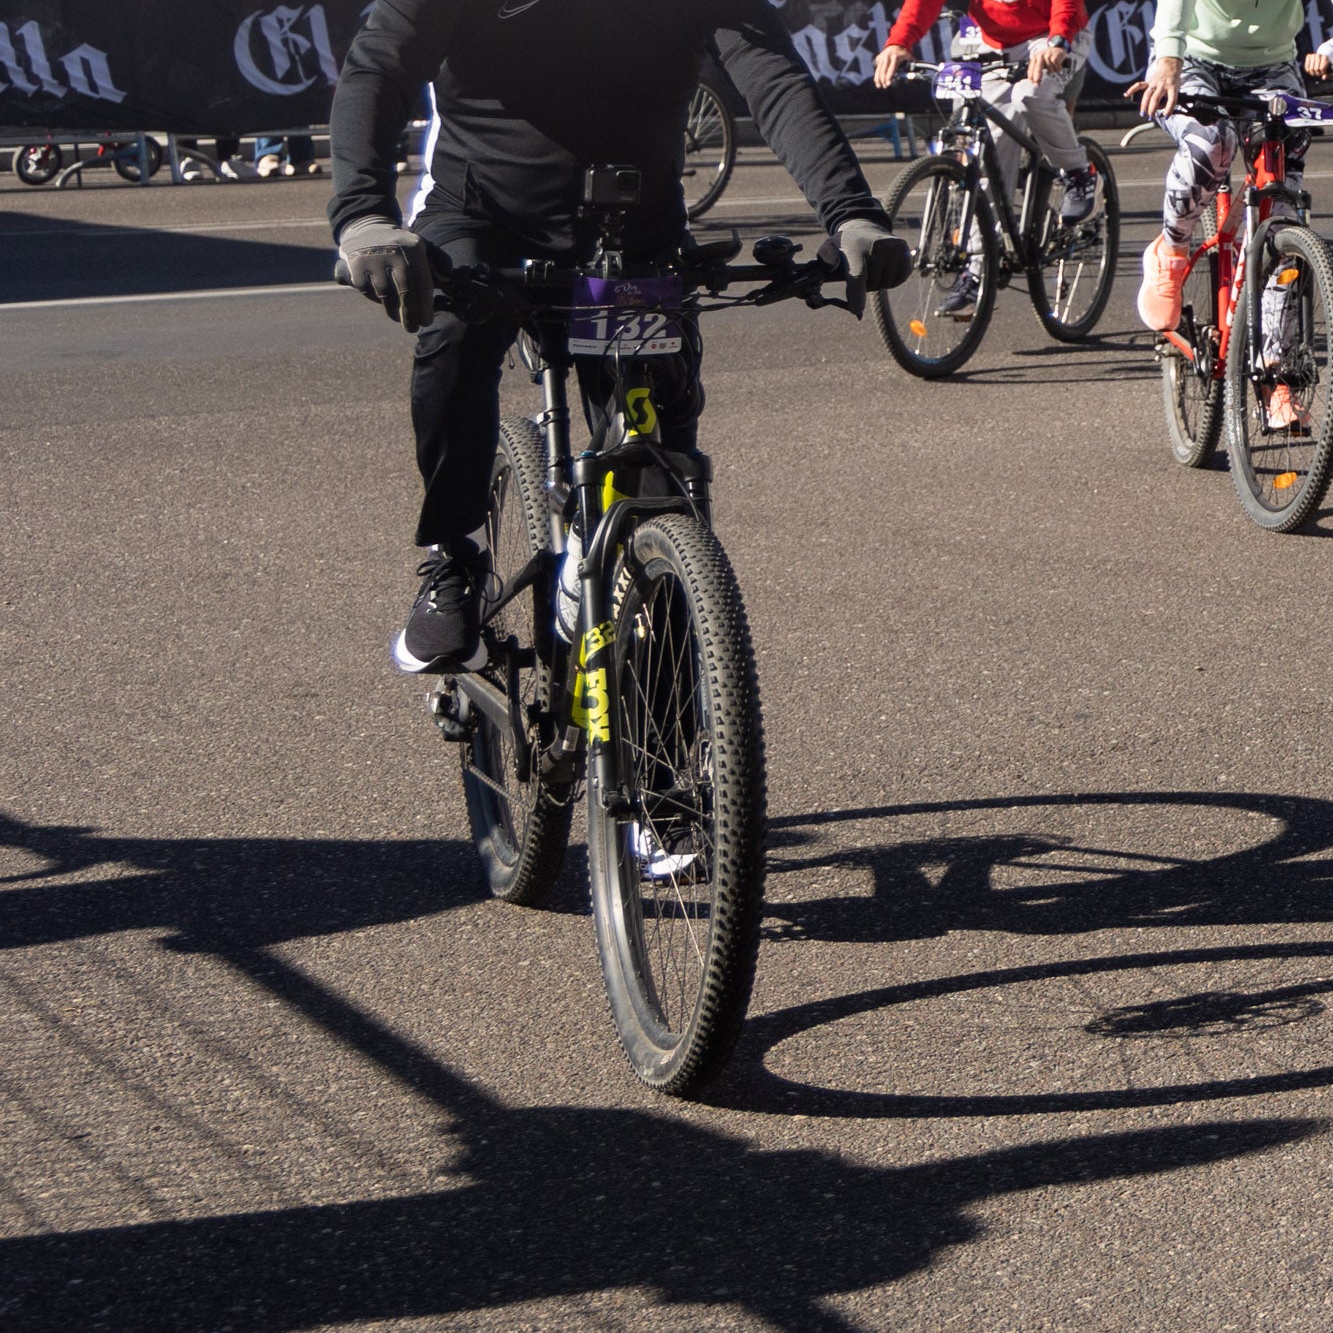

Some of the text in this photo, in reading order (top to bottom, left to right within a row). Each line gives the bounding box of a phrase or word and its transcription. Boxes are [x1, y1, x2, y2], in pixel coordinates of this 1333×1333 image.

[234, 4, 341, 96] El
[1297, 106, 1322, 120] 37
[591, 310, 667, 340] 132
[585, 667, 611, 746] FOX
